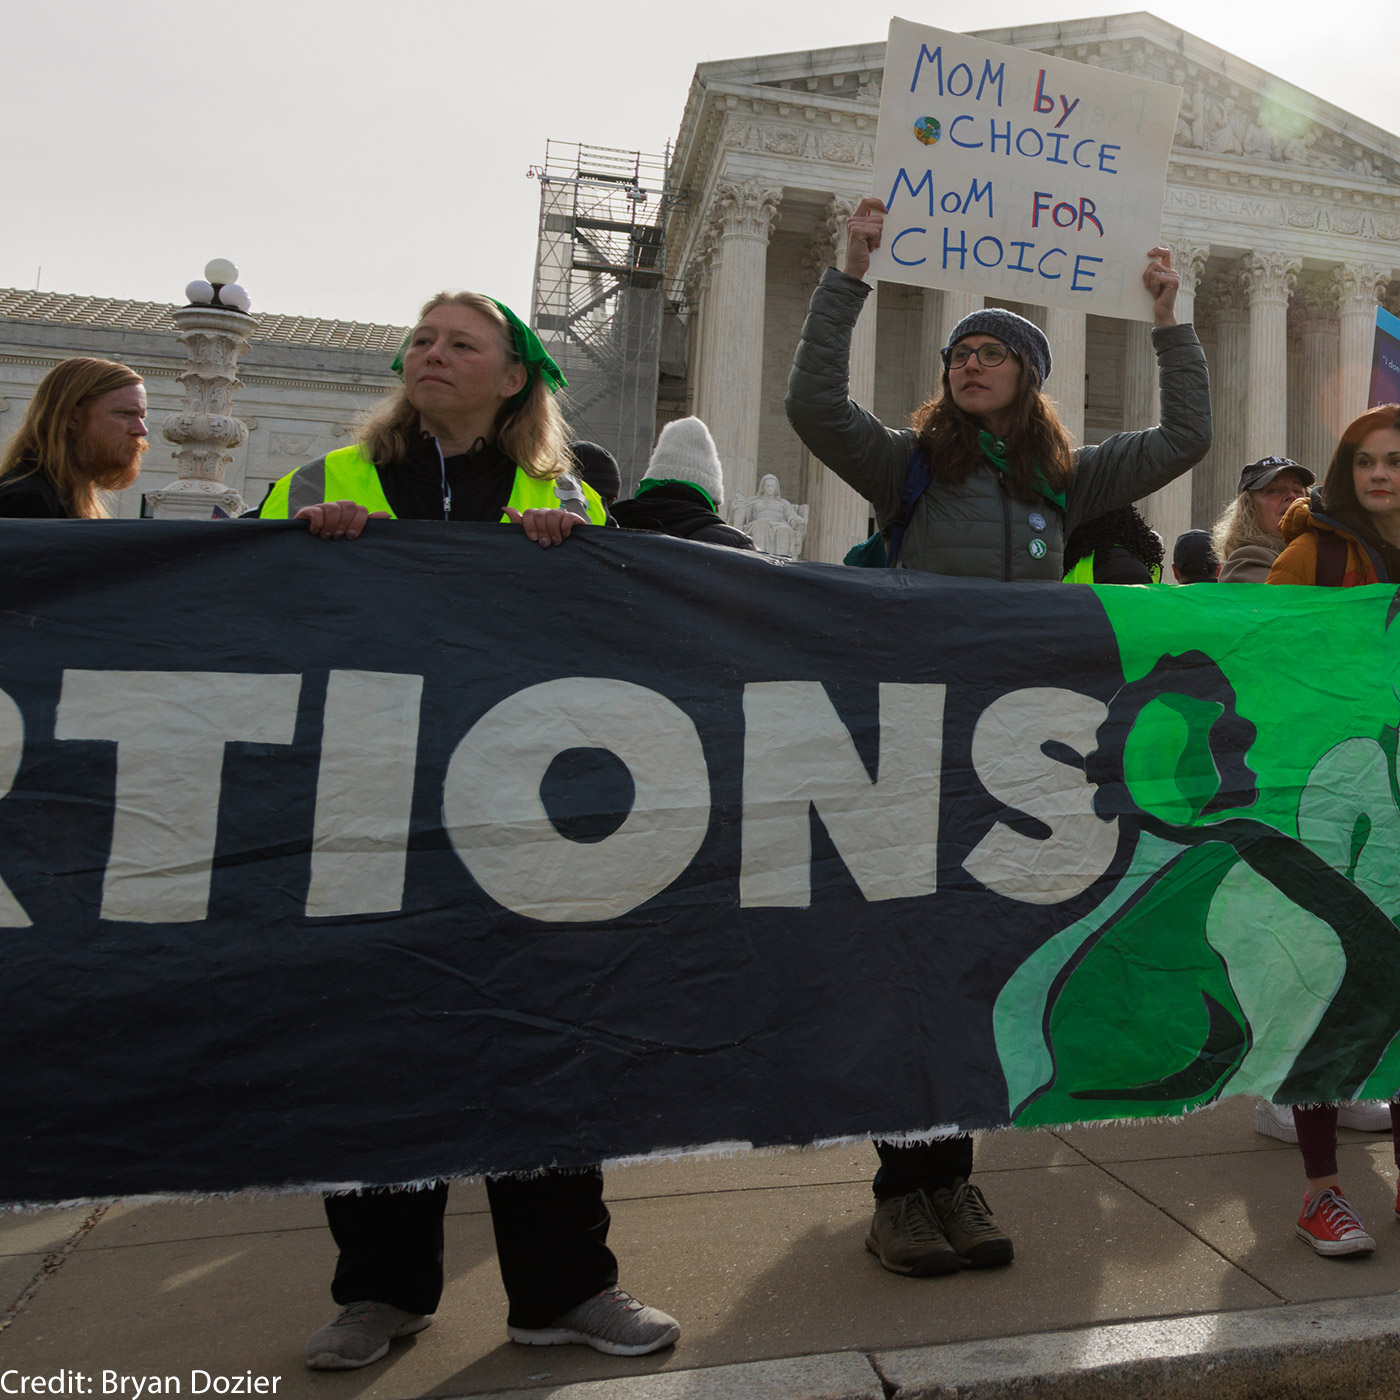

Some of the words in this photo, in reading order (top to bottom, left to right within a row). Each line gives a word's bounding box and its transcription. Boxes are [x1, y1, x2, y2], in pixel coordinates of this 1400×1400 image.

[1033, 69, 1080, 128] by
[949, 115, 1121, 174] CHOICE
[1032, 191, 1104, 238] FOR
[1229, 199, 1267, 217] LAW
[891, 227, 1103, 291] CHOICE
[0, 669, 1120, 928] TIONS
